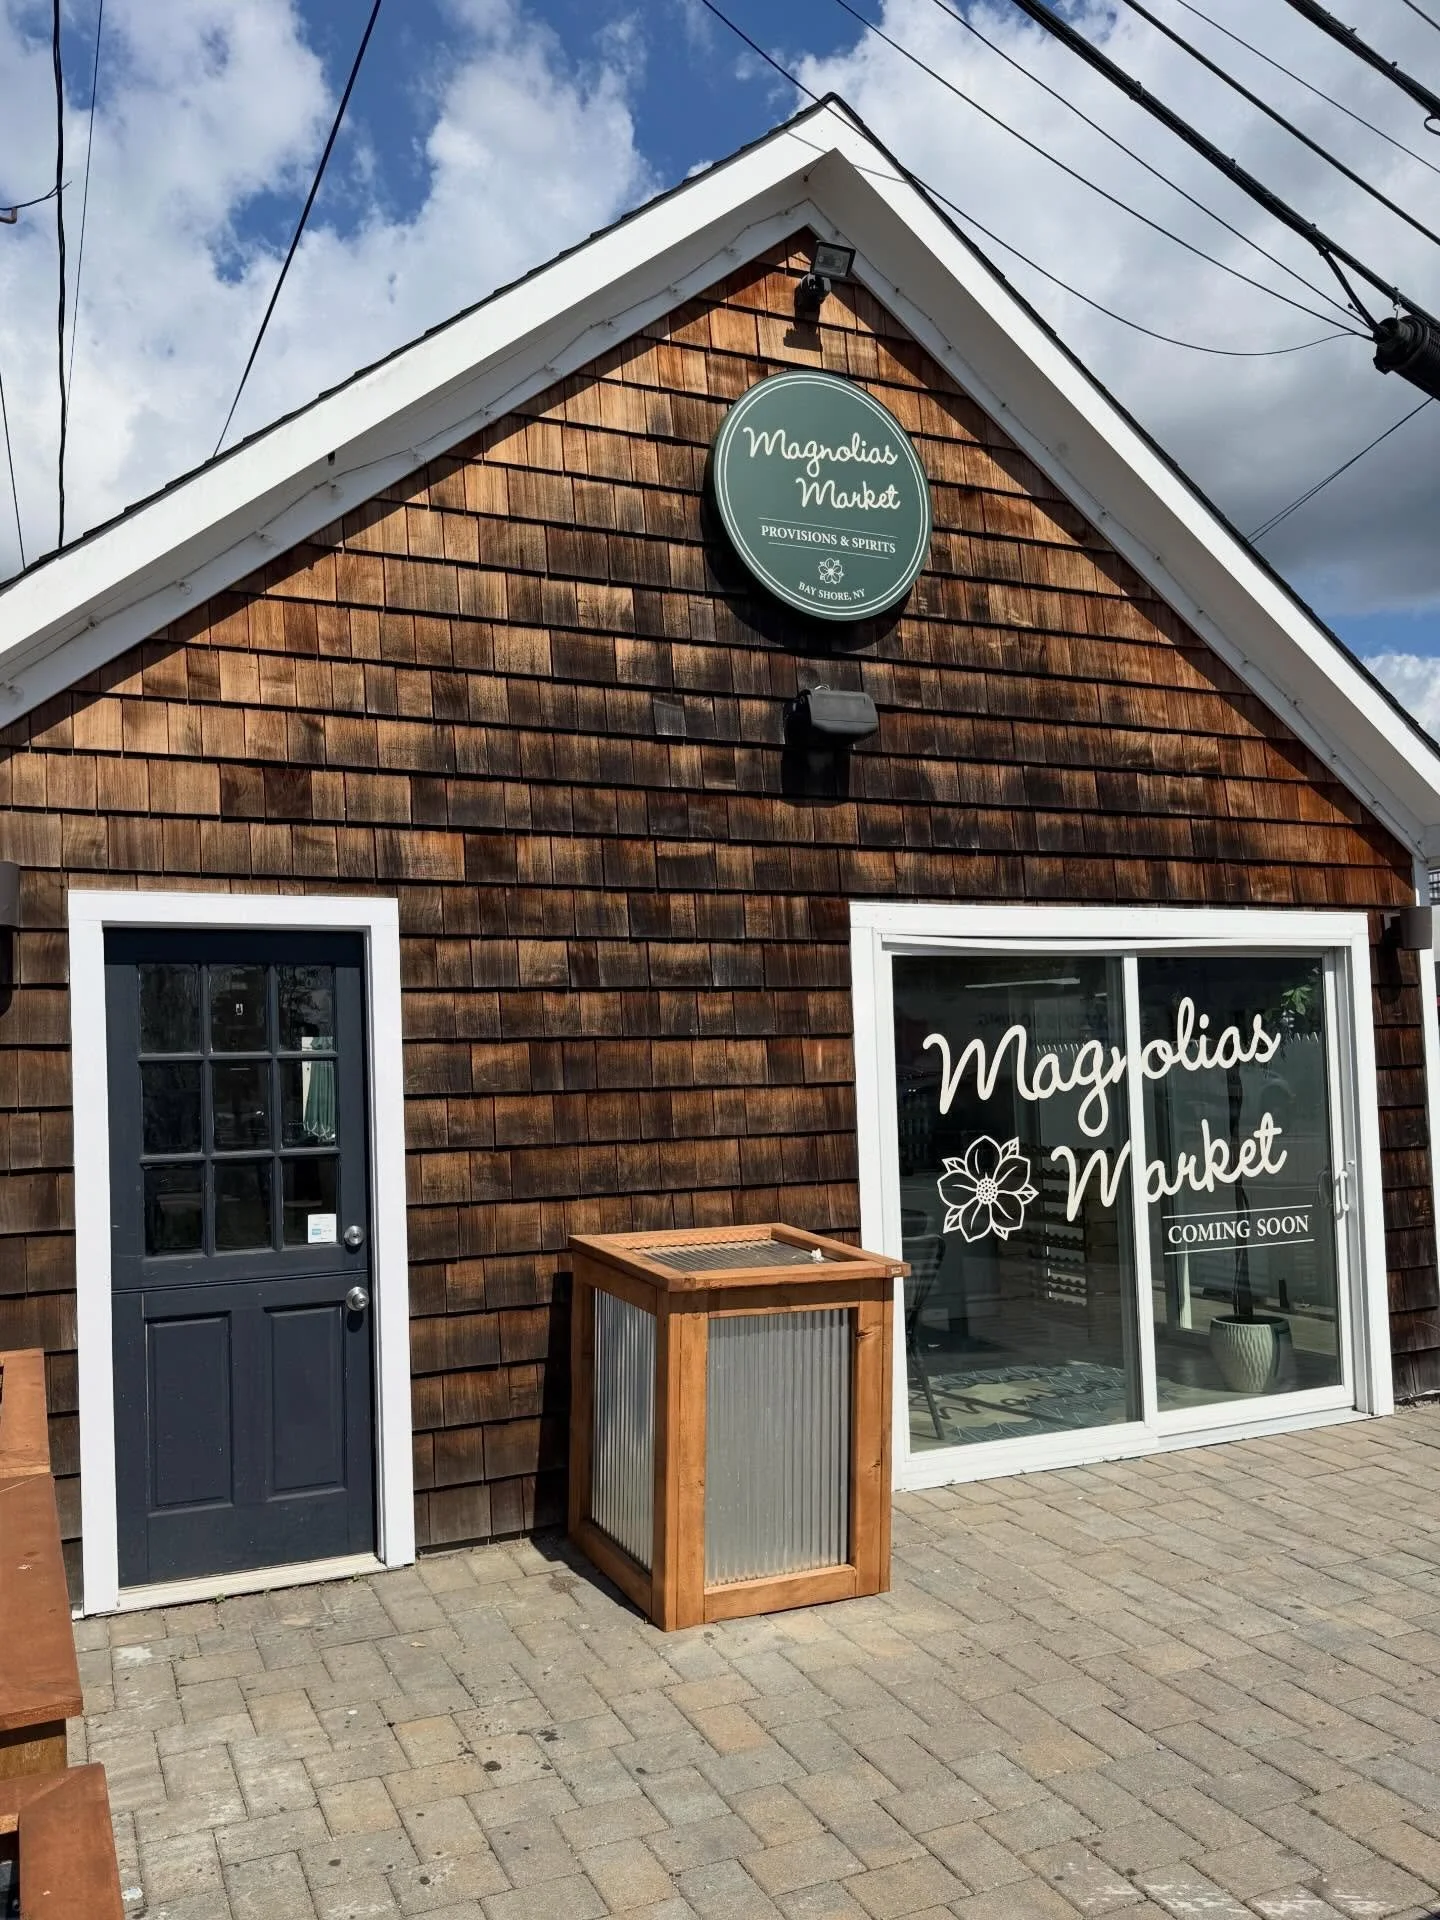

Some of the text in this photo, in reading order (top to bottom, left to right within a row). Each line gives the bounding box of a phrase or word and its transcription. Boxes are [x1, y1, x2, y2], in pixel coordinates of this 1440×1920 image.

[743, 426, 898, 477] Magnolias
[795, 477, 901, 510] Market
[761, 525, 896, 554] PROVISIONS & SPIRITS
[798, 581, 865, 601] BAY SHORE, NY
[1050, 1112, 1288, 1222] Market
[1168, 1215, 1309, 1244] COMING SOON
